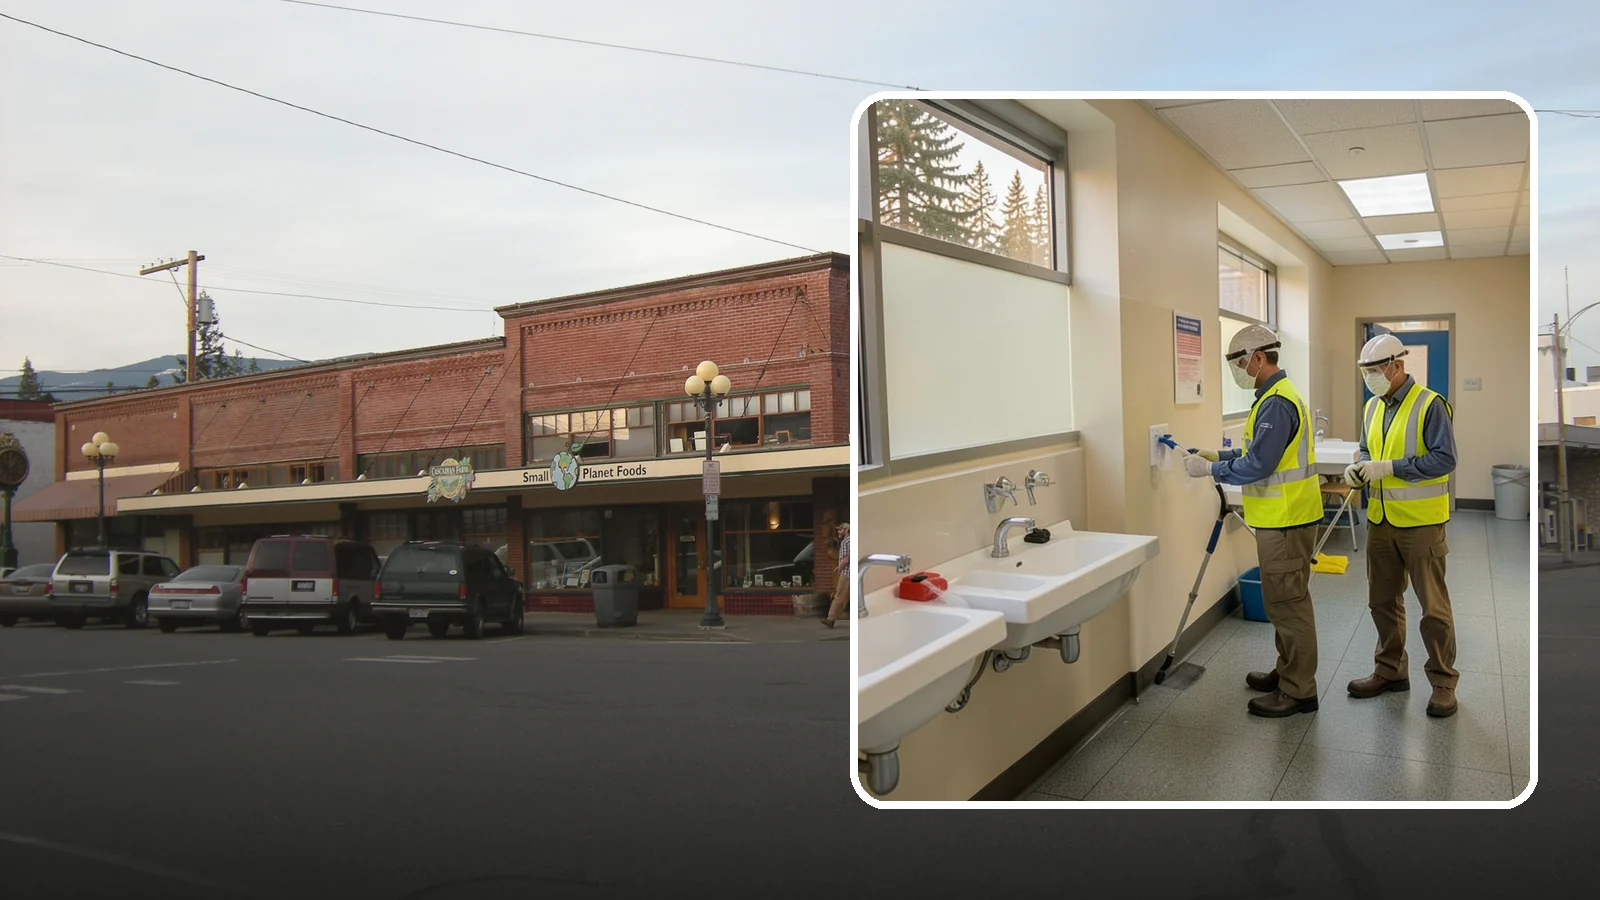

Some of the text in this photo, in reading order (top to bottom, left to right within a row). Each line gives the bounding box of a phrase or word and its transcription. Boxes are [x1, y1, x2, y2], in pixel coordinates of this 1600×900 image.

[523, 464, 647, 483] Small Planet Foods
